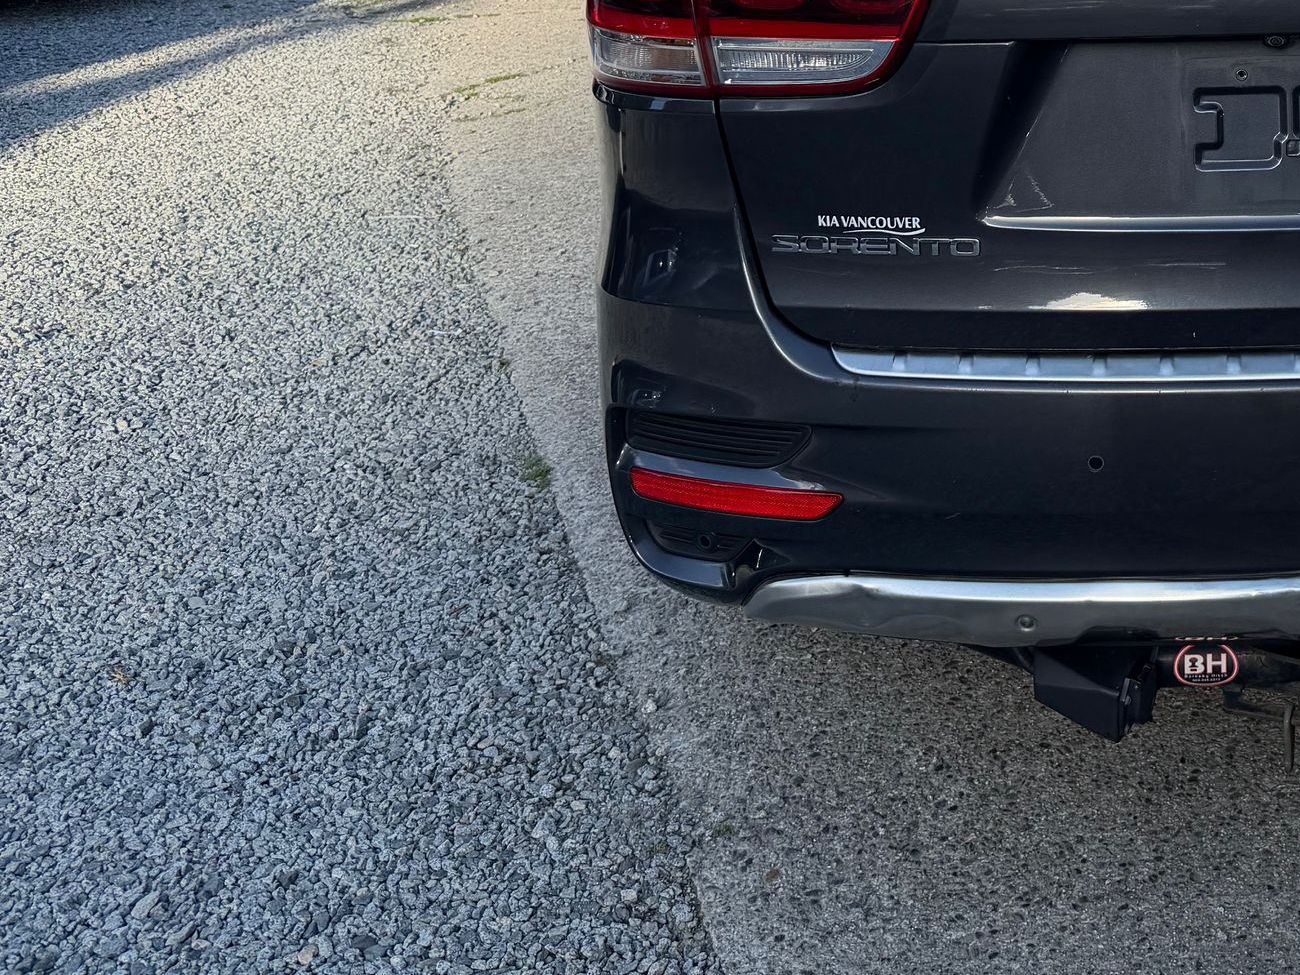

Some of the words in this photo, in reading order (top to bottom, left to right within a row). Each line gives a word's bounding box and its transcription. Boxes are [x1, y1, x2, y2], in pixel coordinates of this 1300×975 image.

[818, 215, 840, 227] KIA
[841, 216, 921, 229] VANCOUVER
[771, 234, 981, 257] SORENTO
[1184, 653, 1228, 674] BH
